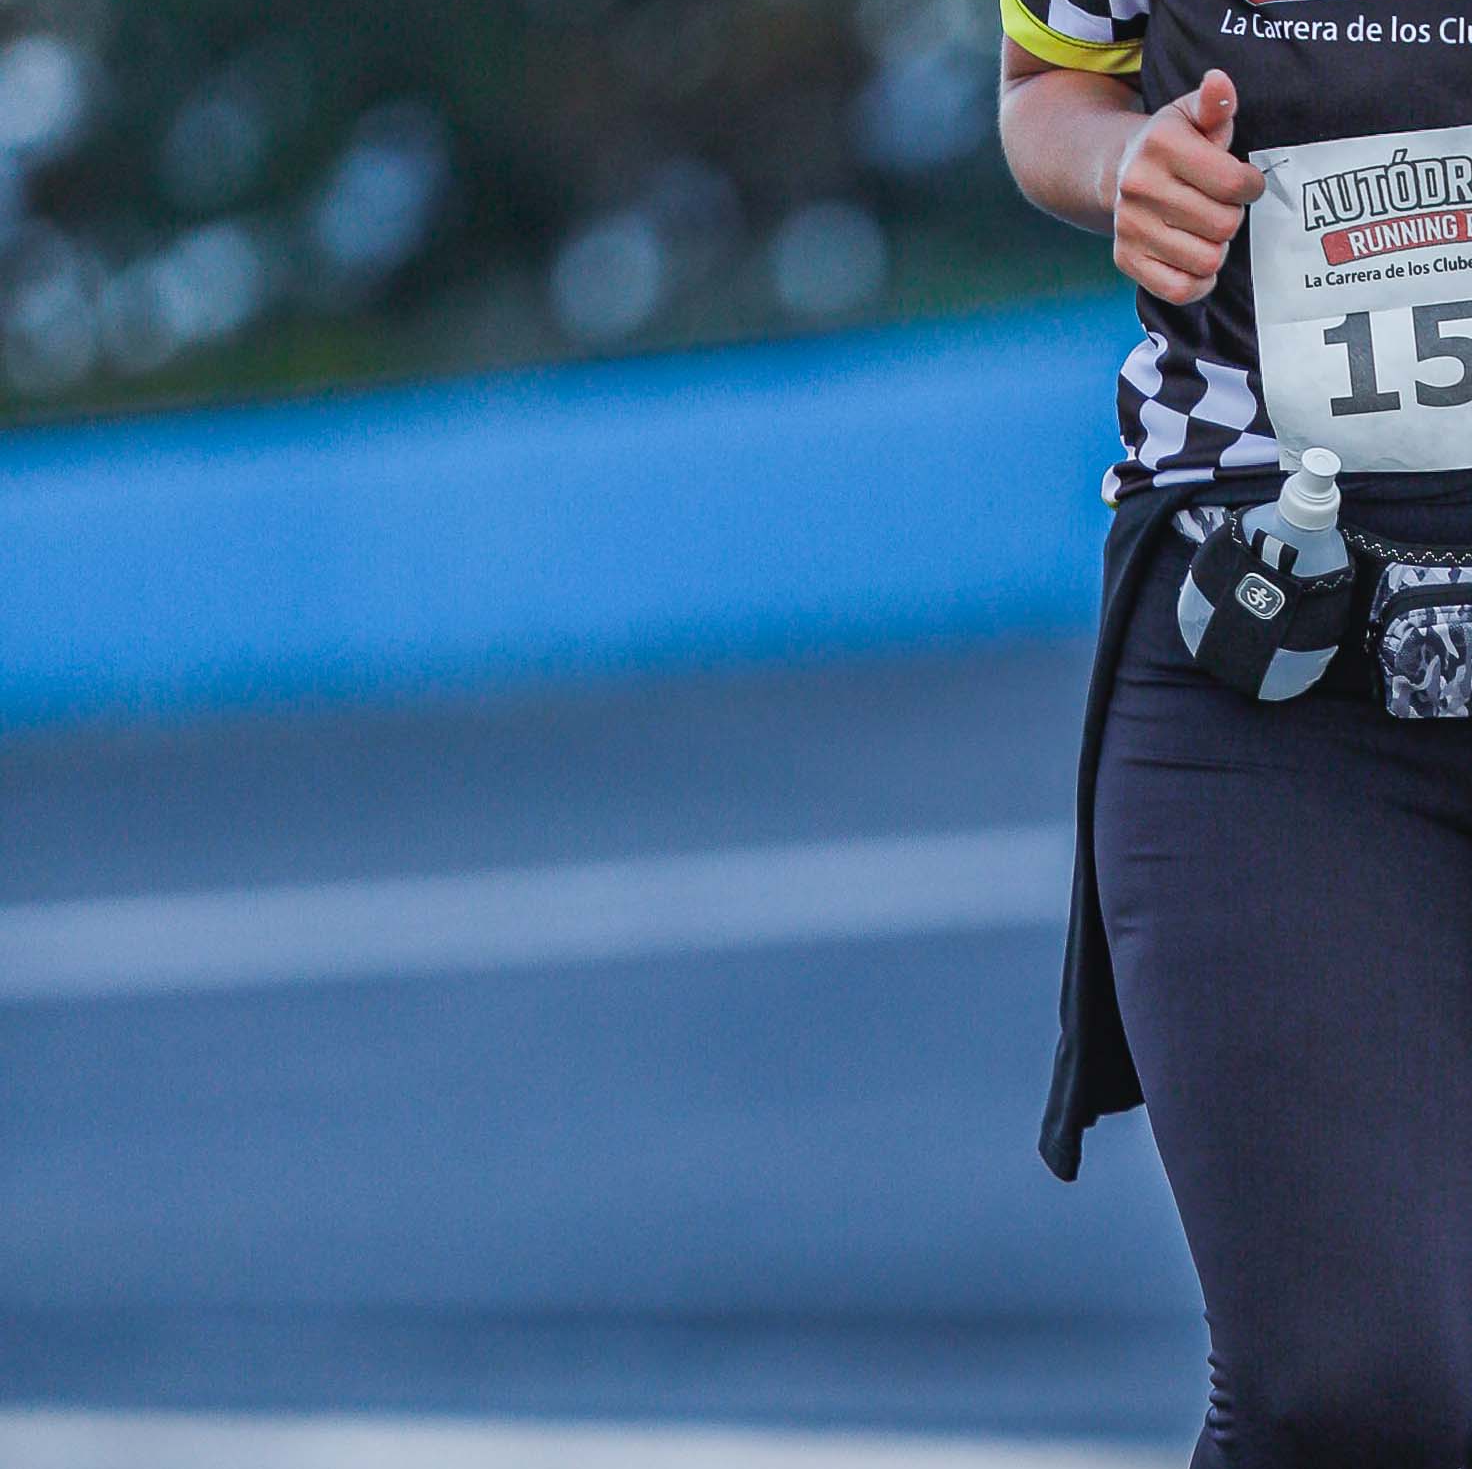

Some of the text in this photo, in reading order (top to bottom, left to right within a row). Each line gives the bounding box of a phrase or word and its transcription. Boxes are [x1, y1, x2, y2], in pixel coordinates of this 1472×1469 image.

[1219, 8, 1247, 36] La
[1252, 13, 1339, 41] Carrera
[1346, 14, 1383, 42] de
[1391, 15, 1431, 43] los
[1347, 214, 1459, 258] RUNNING
[1304, 274, 1322, 288] La
[1325, 268, 1381, 287] Carrera
[1384, 263, 1405, 280] de
[1408, 259, 1430, 277] los
